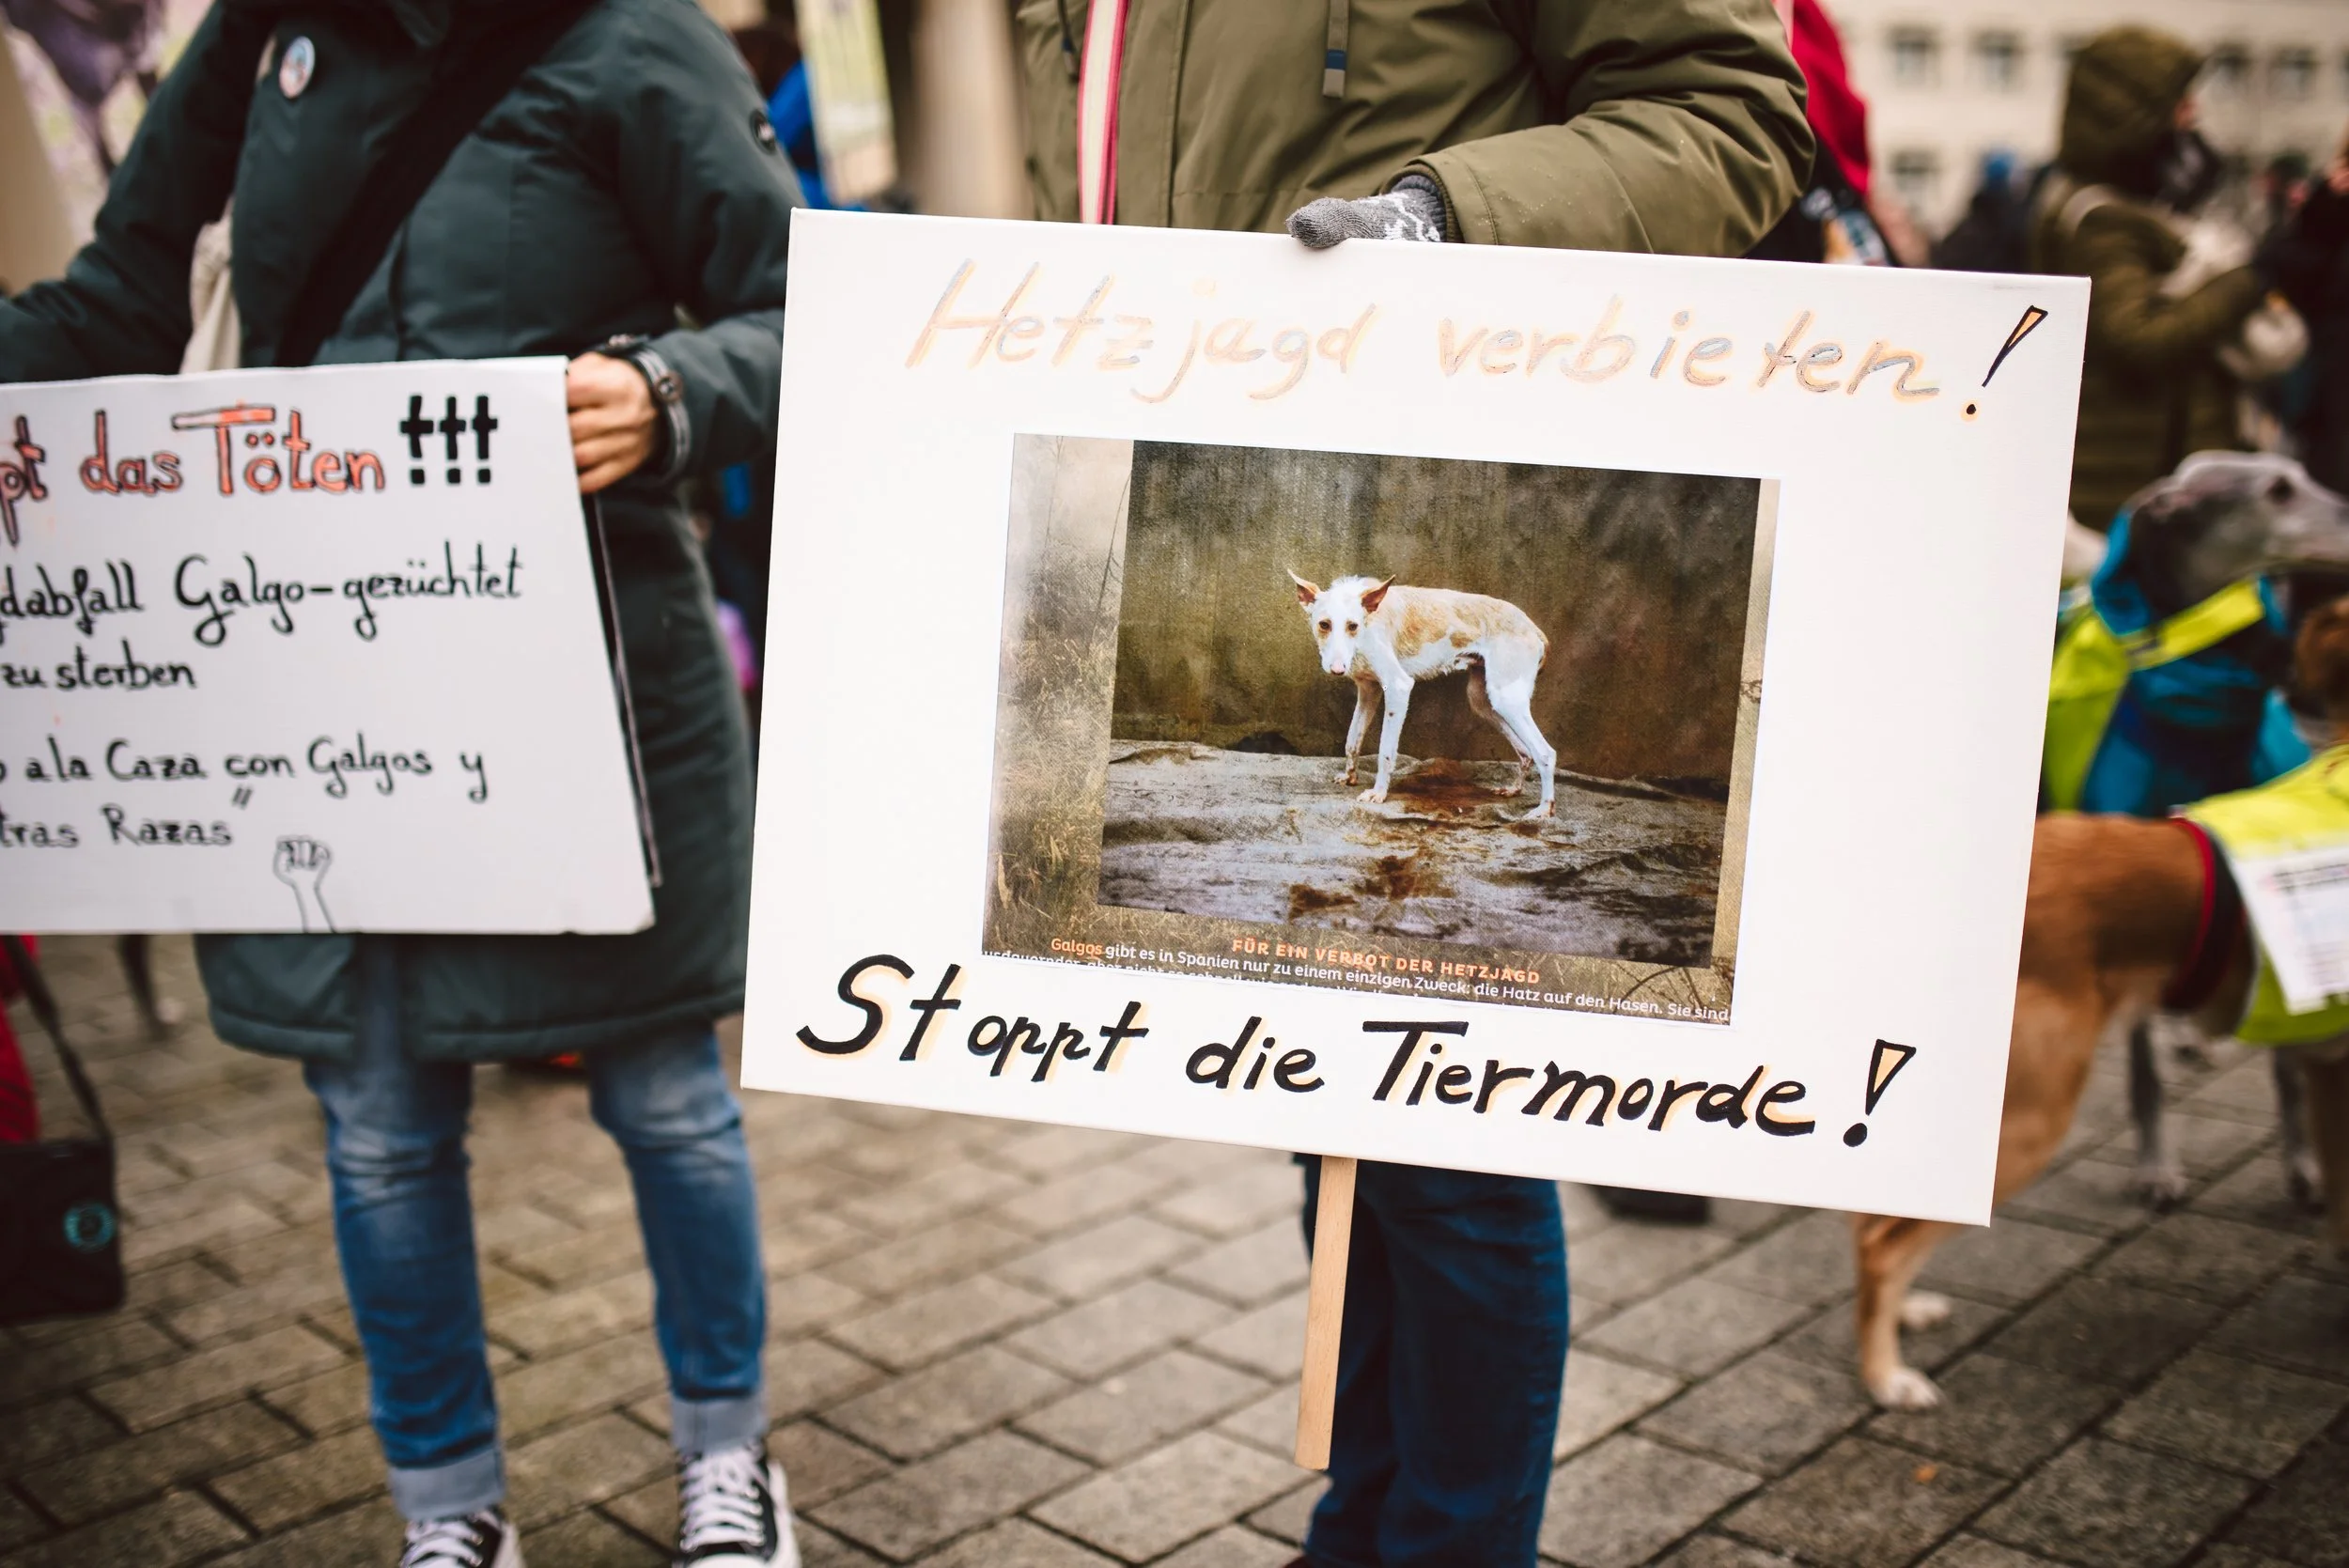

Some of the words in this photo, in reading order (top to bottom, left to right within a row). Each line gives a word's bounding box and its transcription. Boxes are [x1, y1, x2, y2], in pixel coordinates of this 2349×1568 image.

[79, 409, 184, 498] das
[171, 402, 386, 496] Töten
[55, 638, 197, 691] sterben
[106, 738, 208, 782] Caza
[224, 752, 294, 778] con
[307, 732, 432, 799] Galgos
[459, 751, 488, 802] y
[1050, 938, 1102, 956] Galgos
[1105, 944, 1136, 959] gibt
[1139, 949, 1156, 960] es
[1159, 949, 1174, 963] in
[1177, 951, 1239, 970] Spanien
[1243, 960, 1270, 972] nur
[1273, 963, 1291, 975] zu
[1295, 965, 1341, 980] einem
[1346, 970, 1410, 988] einzigen
[1474, 983, 1499, 997] die
[1502, 986, 1540, 1002] Hatz
[1544, 992, 1572, 1005] auf
[1576, 994, 1605, 1009] den
[1610, 997, 1663, 1016] Hasen.
[1668, 1002, 1690, 1017] Sie
[1694, 1005, 1729, 1021] sind
[1232, 938, 1269, 955] FÜR
[1276, 943, 1308, 959] EIN
[1315, 947, 1390, 968] VERBOT
[1396, 957, 1433, 973] DER
[1440, 962, 1540, 984] HETZJAGD
[795, 954, 1149, 1082] Stoppt
[1185, 1016, 1325, 1093] die
